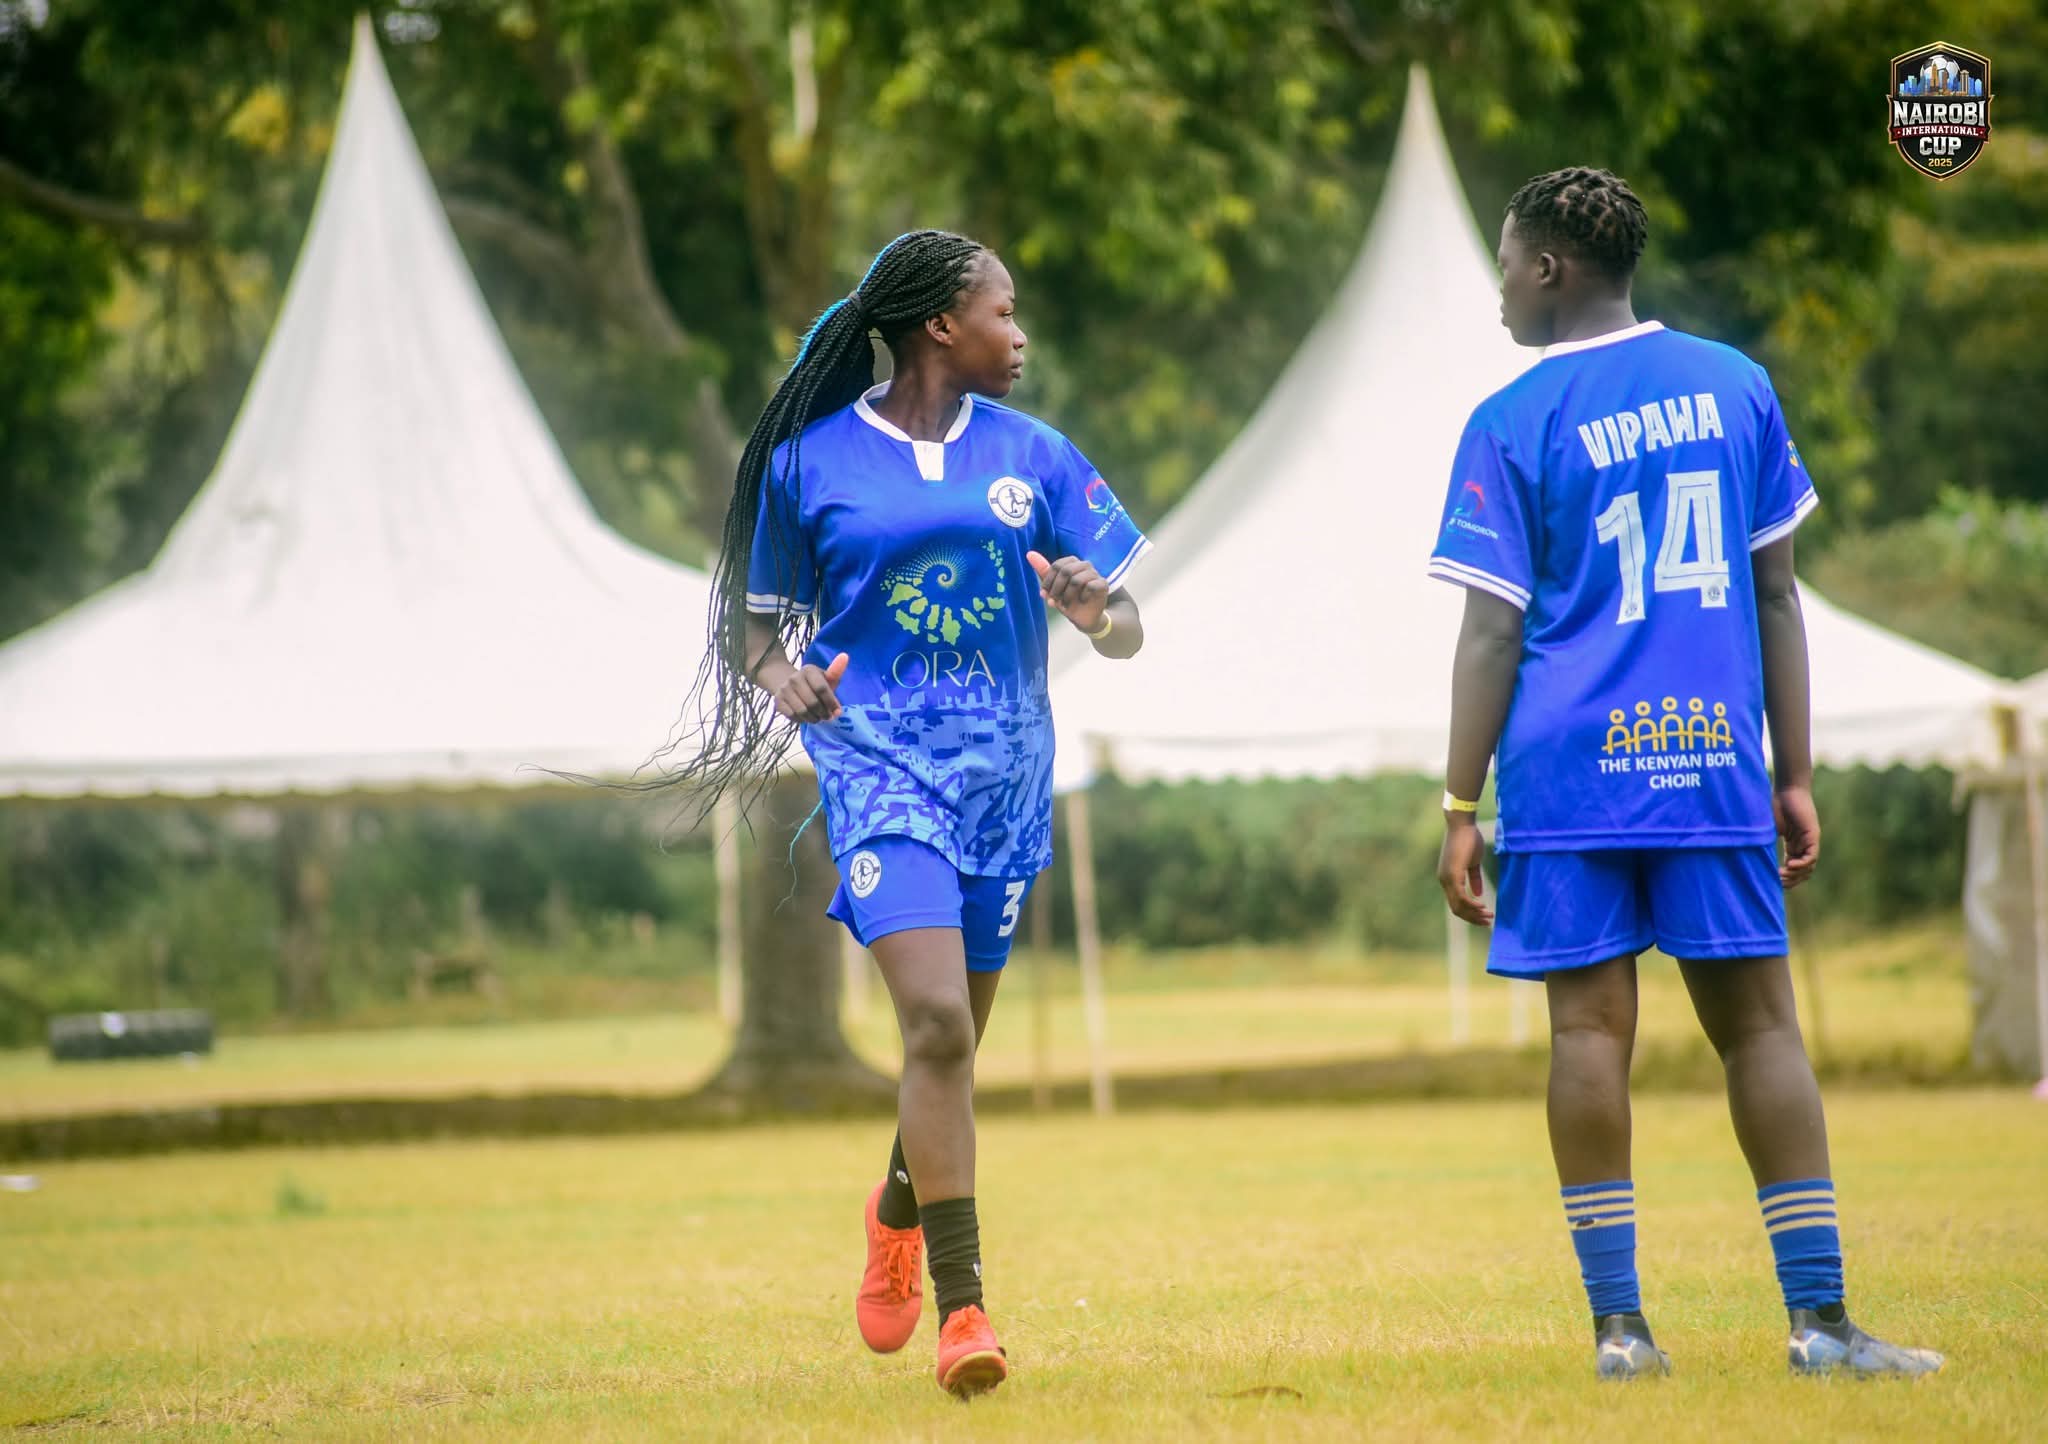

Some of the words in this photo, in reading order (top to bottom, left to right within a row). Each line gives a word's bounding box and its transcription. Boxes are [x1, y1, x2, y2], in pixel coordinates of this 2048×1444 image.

[1577, 393, 1724, 469] VIPAWA
[1594, 470, 1730, 625] 14
[892, 649, 996, 689] ORA
[1597, 757, 1632, 774] THE
[1635, 754, 1702, 771] KENYAN
[1705, 751, 1737, 768] BOYS
[1649, 772, 1702, 790] CHOIR
[997, 879, 1026, 937] 3
